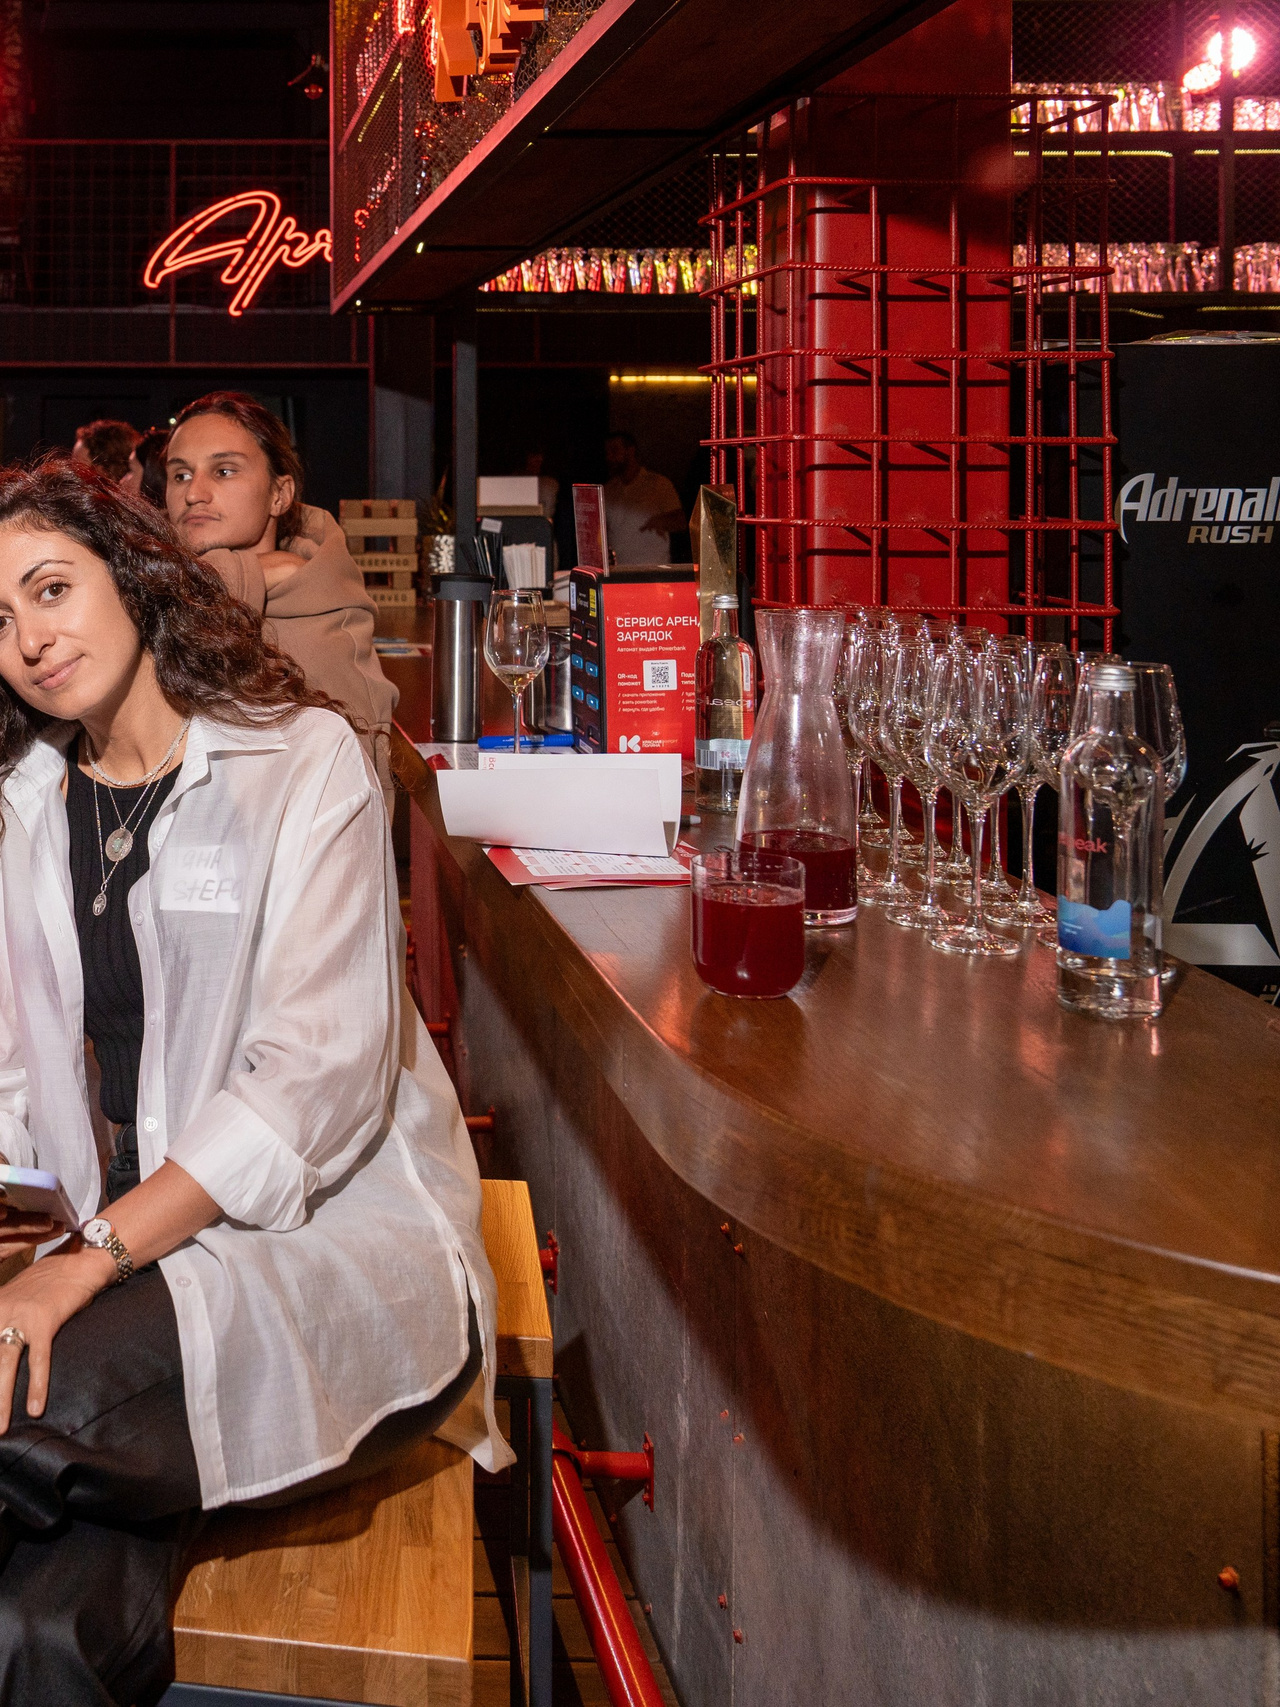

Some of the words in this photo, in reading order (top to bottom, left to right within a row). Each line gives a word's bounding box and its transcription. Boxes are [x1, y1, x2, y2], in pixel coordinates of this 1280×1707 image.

[1115, 473, 1280, 544] Adrenal
[1187, 526, 1274, 543] RUSH
[616, 616, 663, 627] СЕРВИС
[666, 615, 700, 628] АРЕН
[616, 631, 673, 642] ЗАРЯДОК
